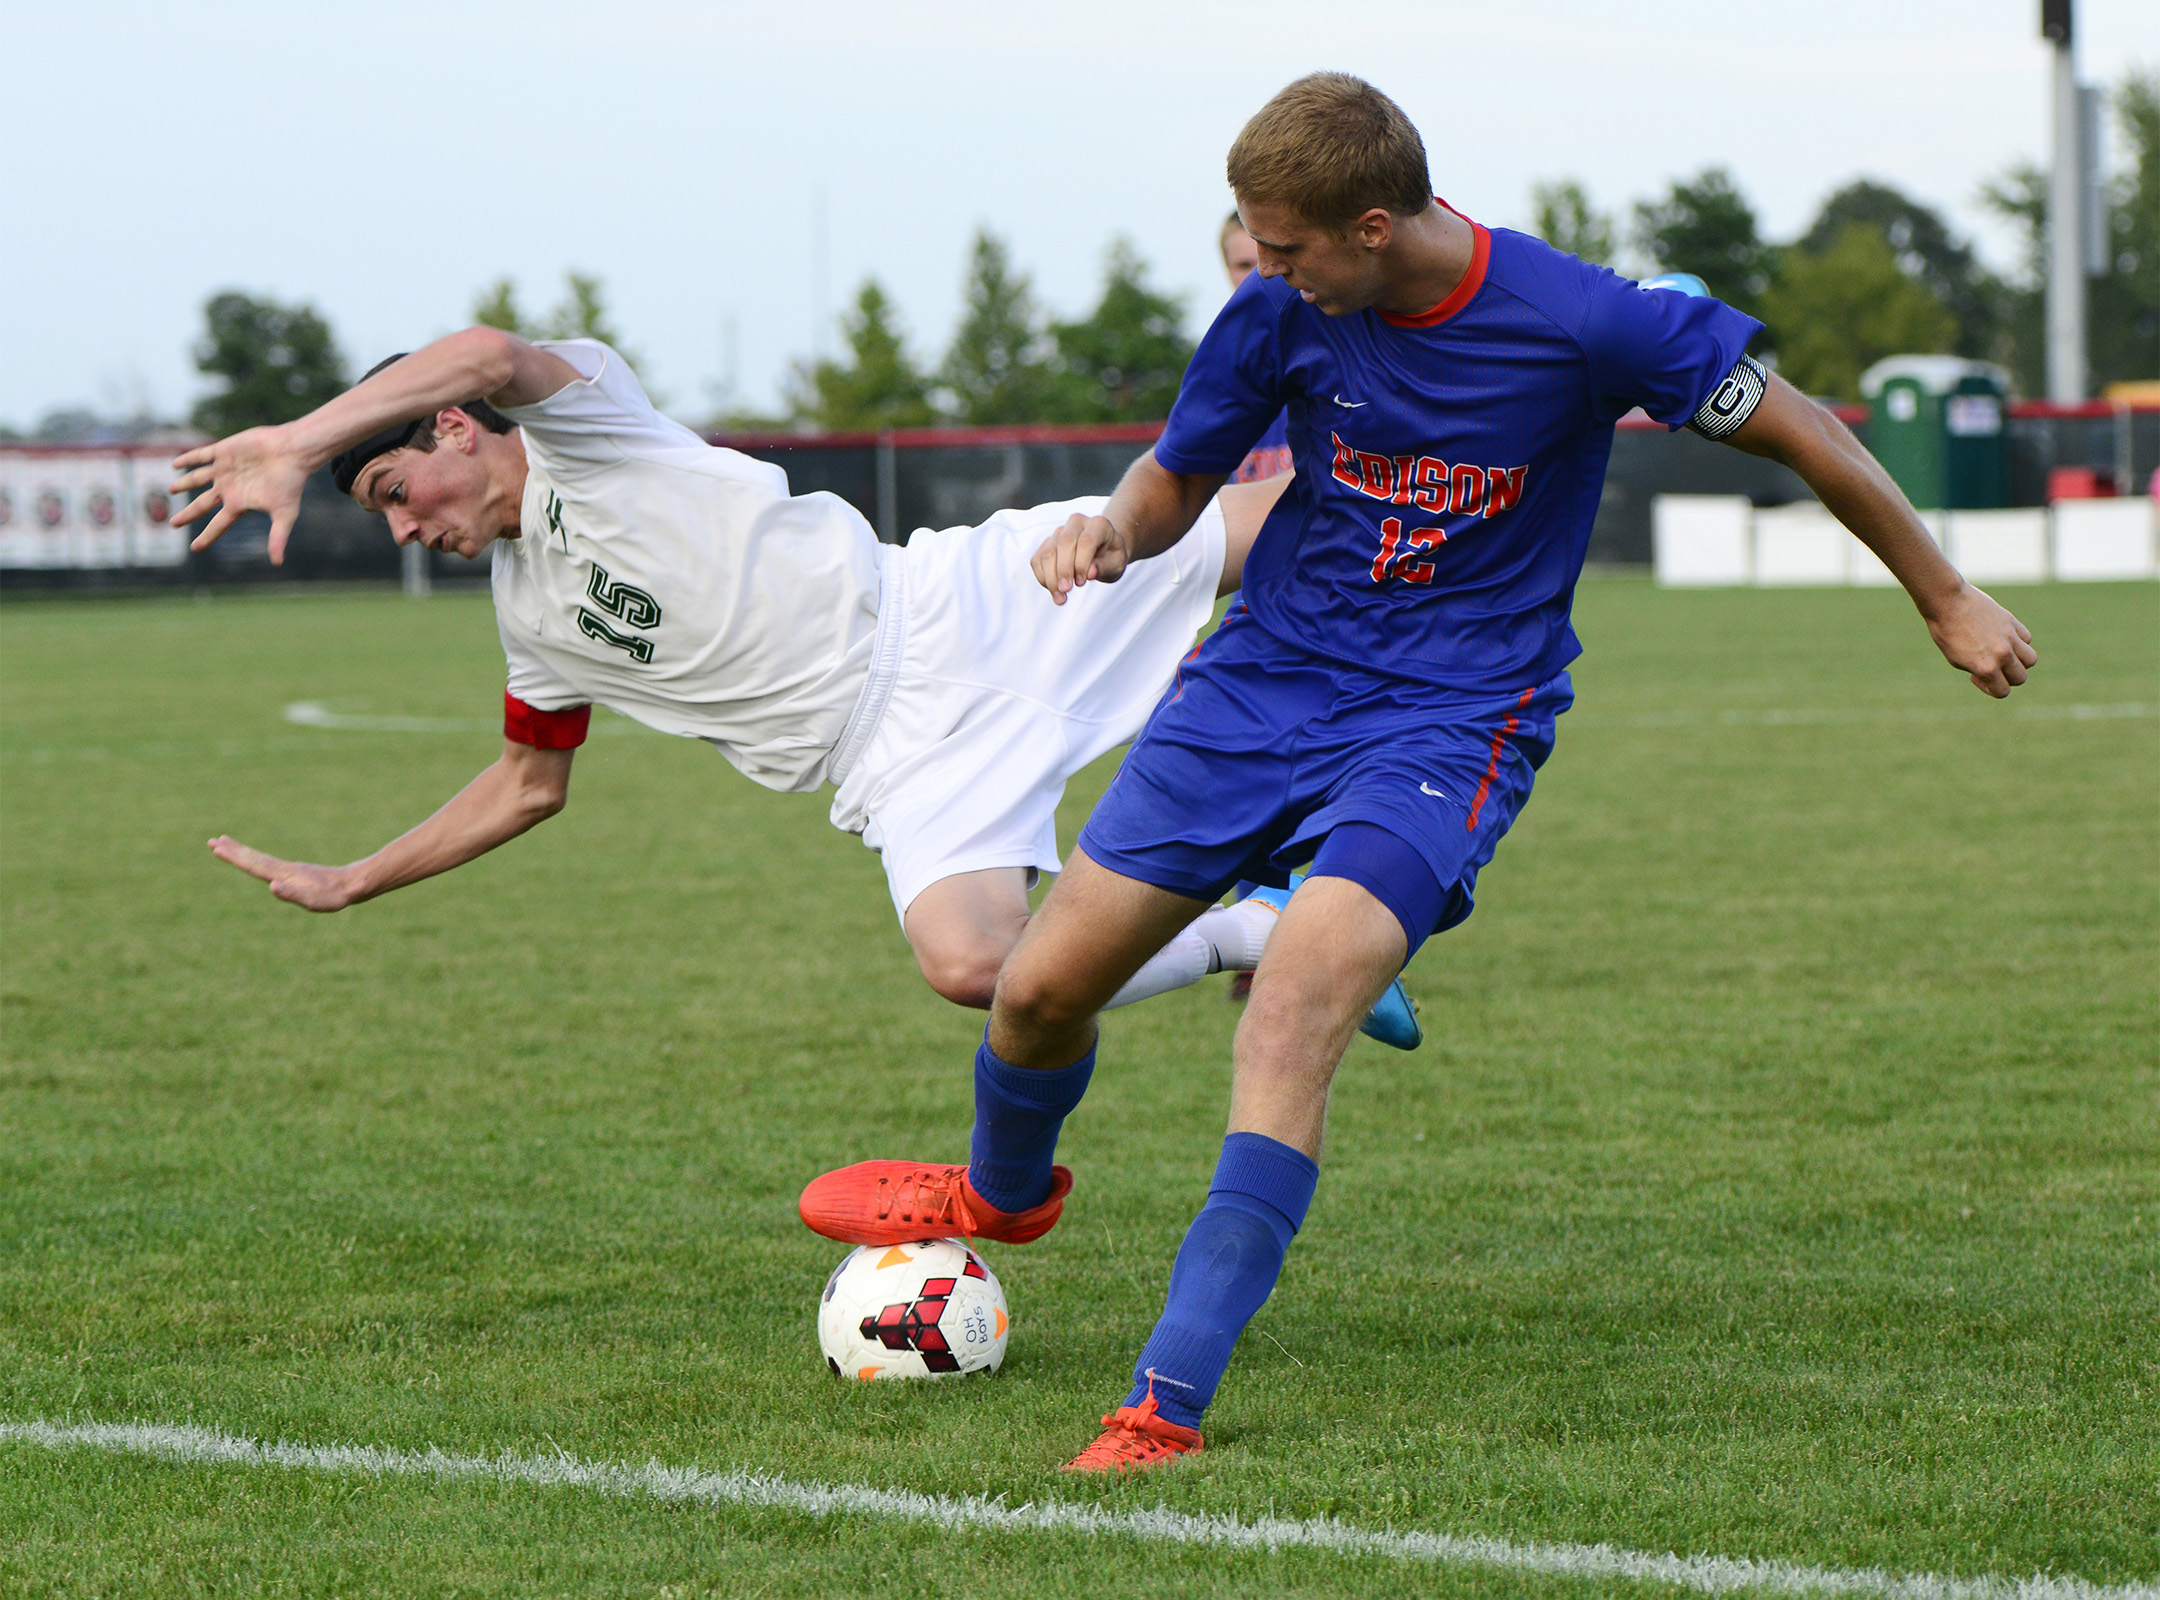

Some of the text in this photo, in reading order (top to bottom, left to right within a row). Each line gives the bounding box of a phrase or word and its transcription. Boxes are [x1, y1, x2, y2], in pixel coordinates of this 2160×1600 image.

[1709, 378, 1746, 418] C
[1332, 430, 1529, 519] EDISON
[1370, 517, 1448, 585] 12
[577, 562, 662, 664] 15
[963, 1317, 977, 1343] OH
[973, 1306, 988, 1344] BOYS
